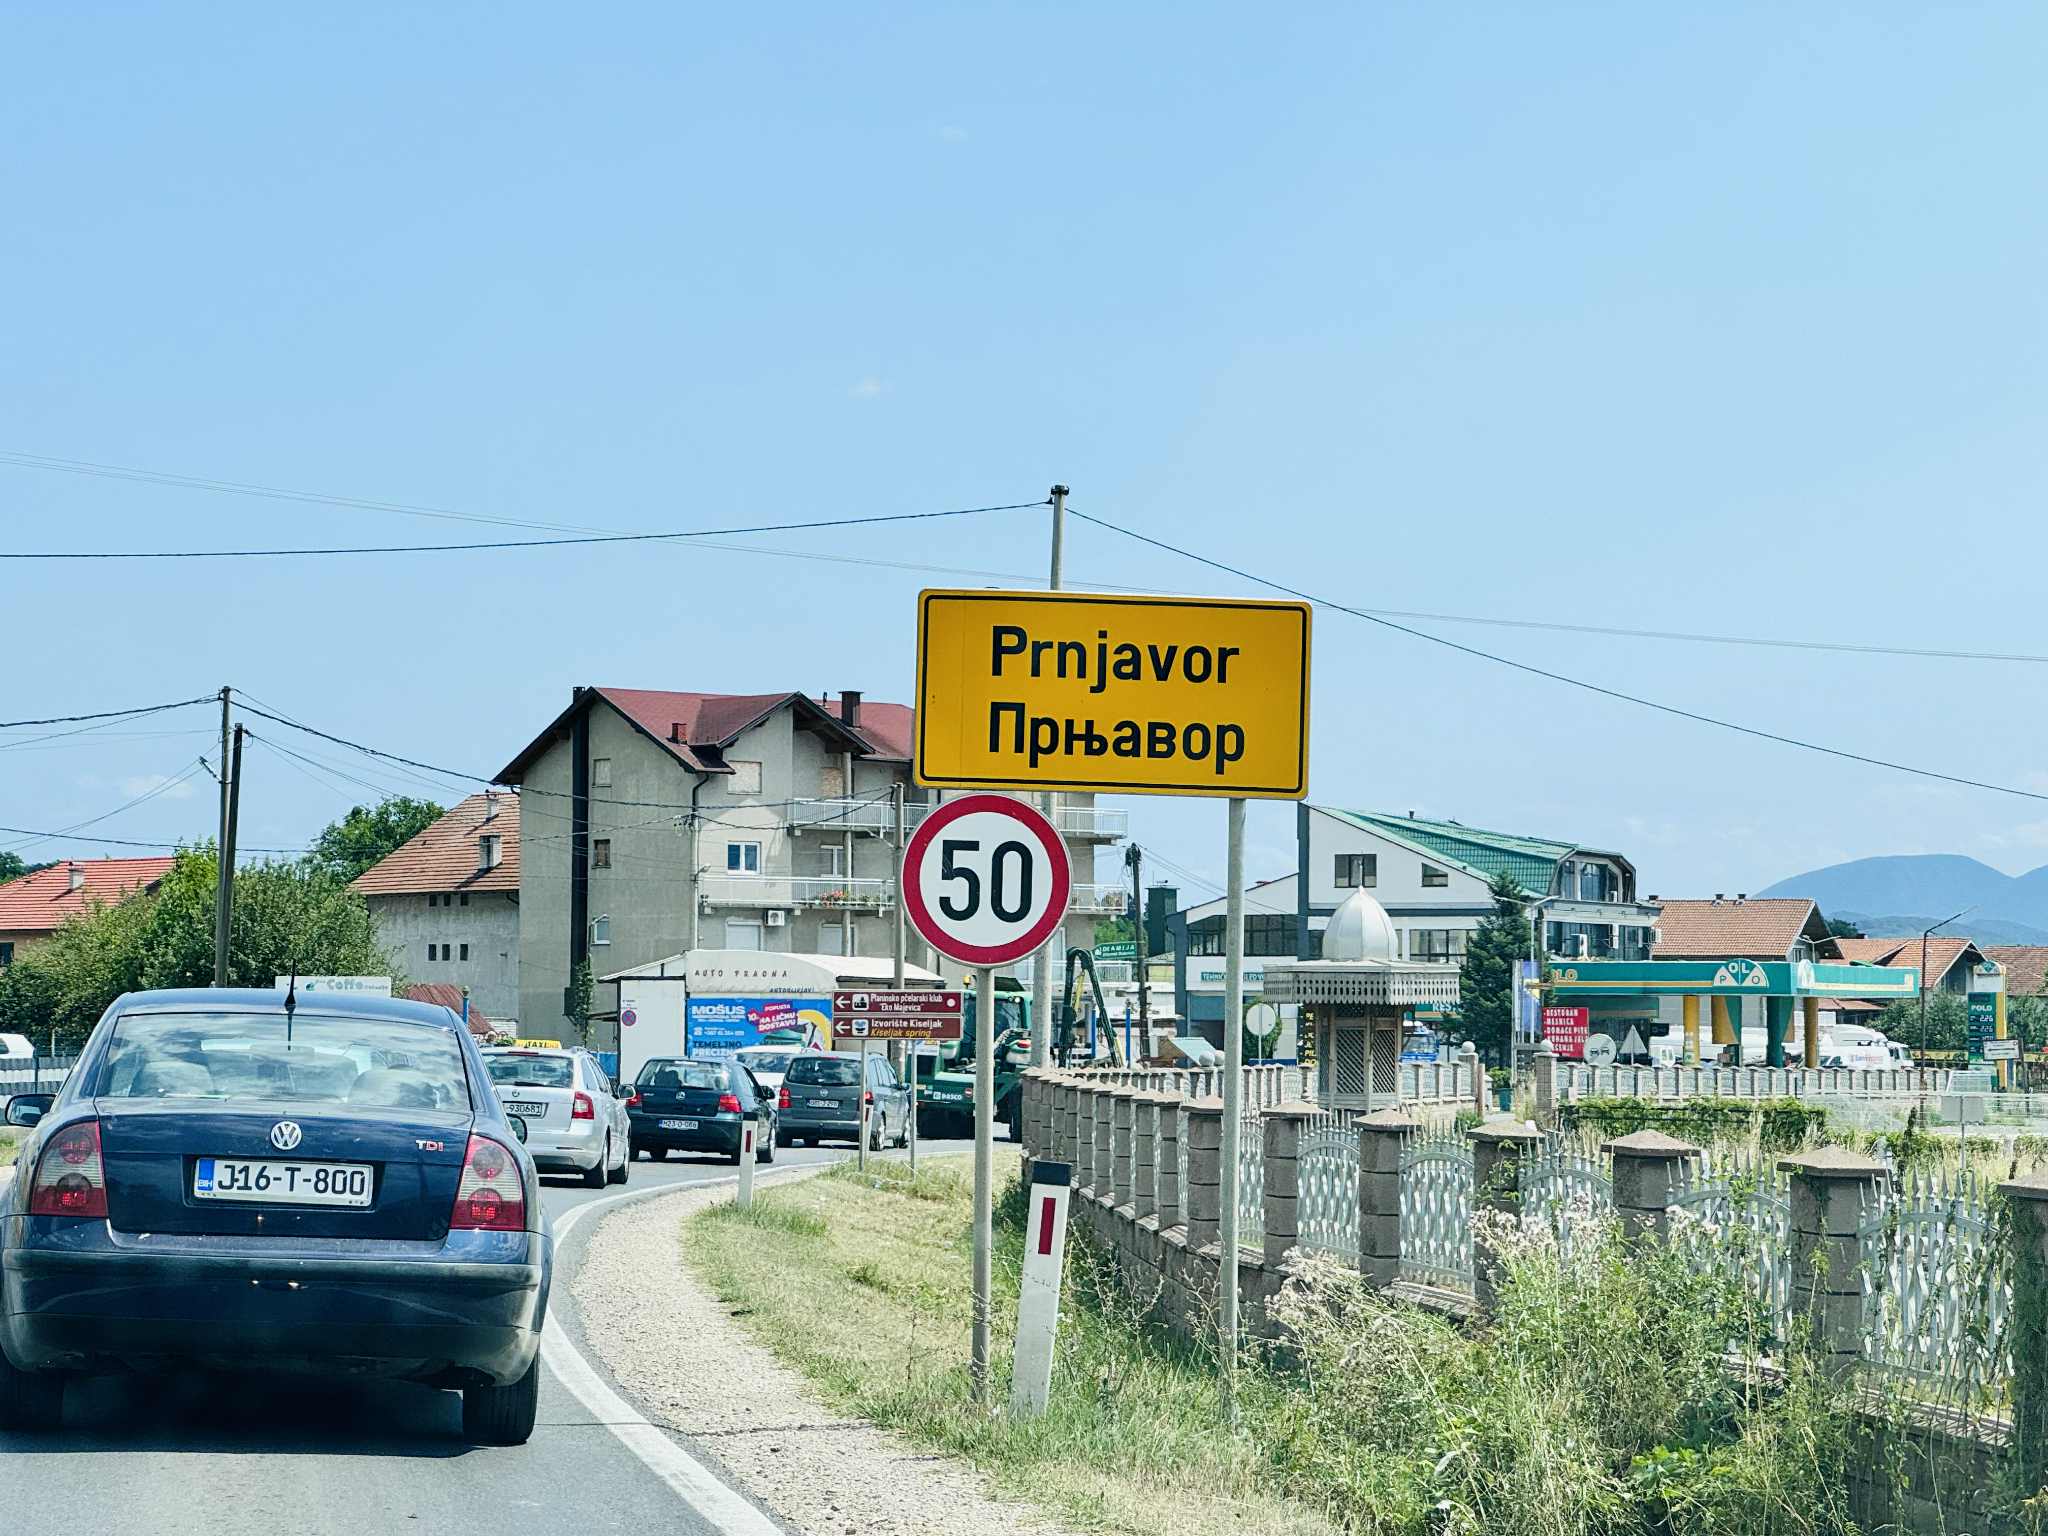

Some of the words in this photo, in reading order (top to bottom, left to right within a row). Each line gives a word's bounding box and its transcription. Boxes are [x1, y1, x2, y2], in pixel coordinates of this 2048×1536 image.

[991, 624, 1240, 694] Prnjavor
[988, 700, 1245, 776] Прњавор
[938, 839, 1033, 923] 50
[929, 993, 943, 1002] klub
[691, 1004, 746, 1015] MOŠUS
[1971, 1004, 1993, 1012] POLO
[871, 1019, 908, 1028] Izvorište
[909, 1019, 943, 1029] Kiseljak
[870, 1028, 903, 1037] Kiseljak
[905, 1029, 931, 1038] spring
[415, 1139, 445, 1152] TDI
[217, 1164, 366, 1196] J16-T-800
